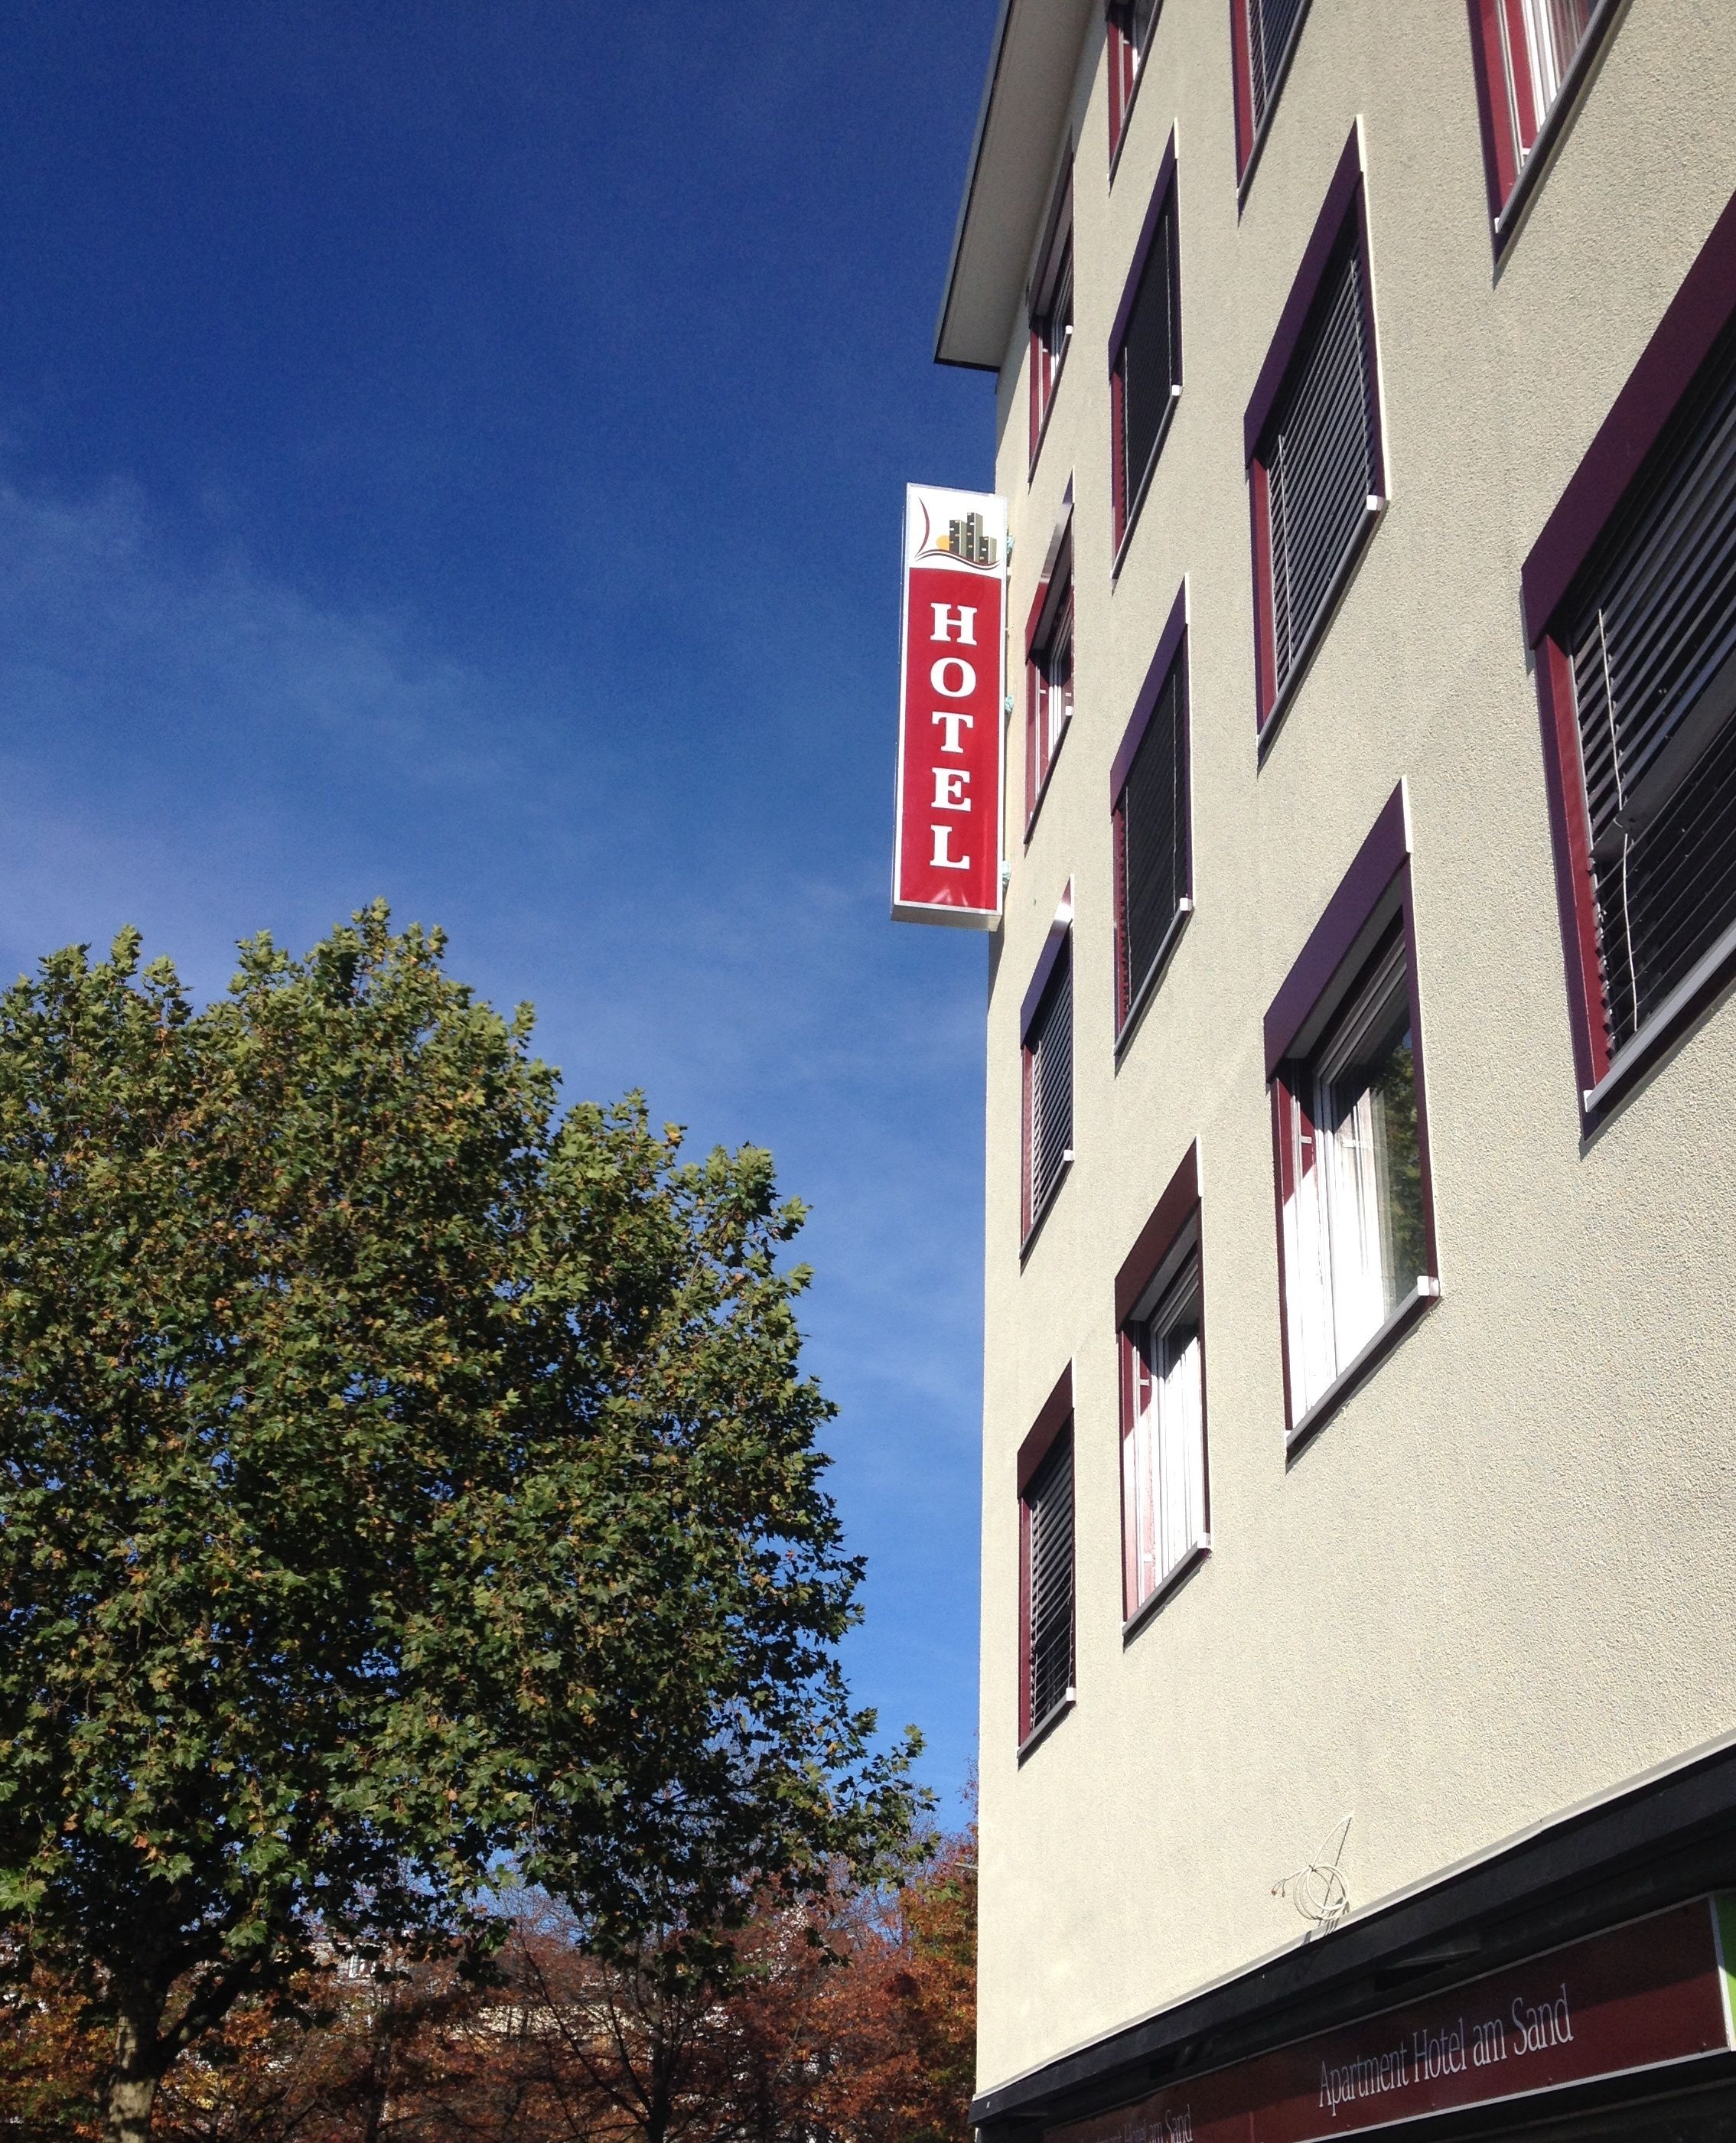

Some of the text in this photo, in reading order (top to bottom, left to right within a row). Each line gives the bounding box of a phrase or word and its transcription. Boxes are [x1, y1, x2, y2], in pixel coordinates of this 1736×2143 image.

[930, 602, 978, 871] HOTEL
[1318, 1983, 1575, 2118] Apartment Hotel am Sand
